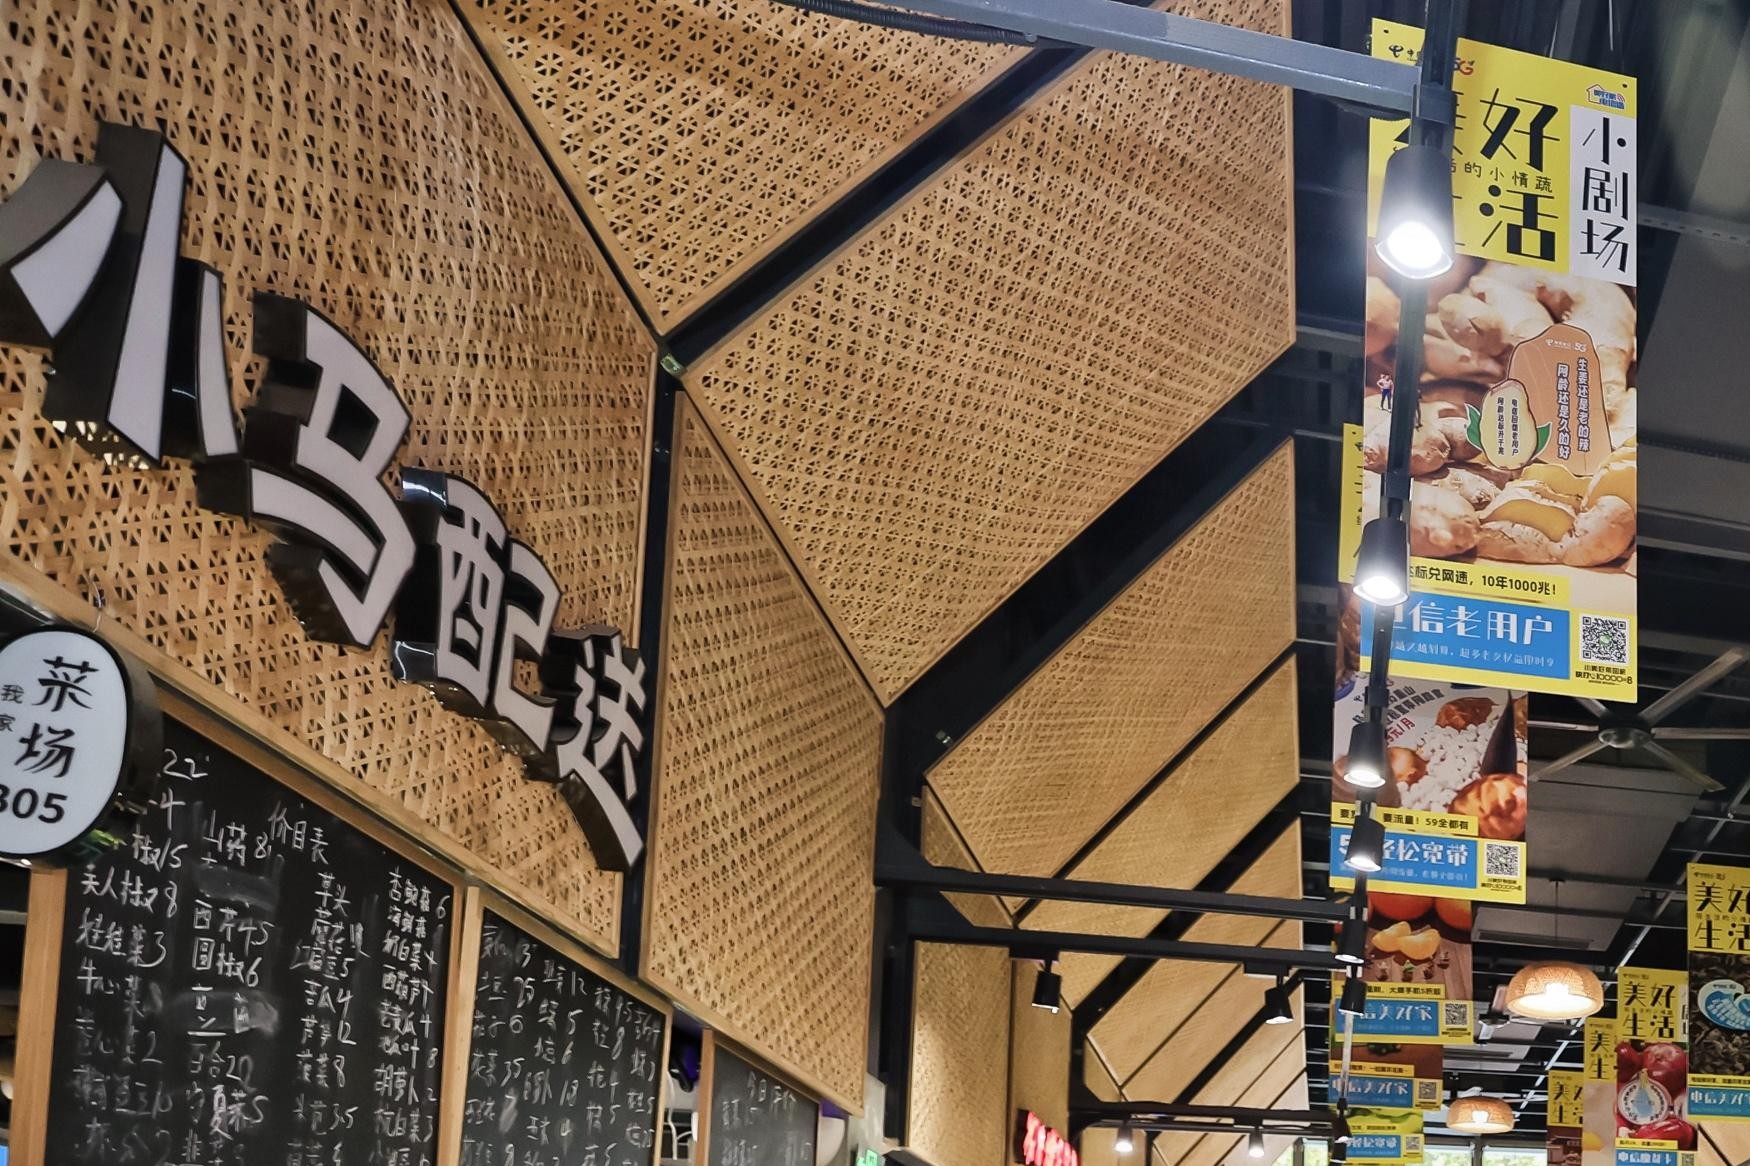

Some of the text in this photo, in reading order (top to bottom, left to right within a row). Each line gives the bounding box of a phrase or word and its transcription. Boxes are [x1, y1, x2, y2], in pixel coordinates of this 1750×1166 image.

[1580, 116, 1630, 273] 小剧场
[1557, 363, 1571, 460] 网龄还是久的好
[1577, 357, 1591, 452] 生姜还是老的辣
[8, 140, 648, 870] 小马配送
[14, 656, 100, 779] 菜场
[267, 801, 329, 865] 价目表
[1623, 1012, 1675, 1039] 生活
[1624, 980, 1676, 1008] 美好
